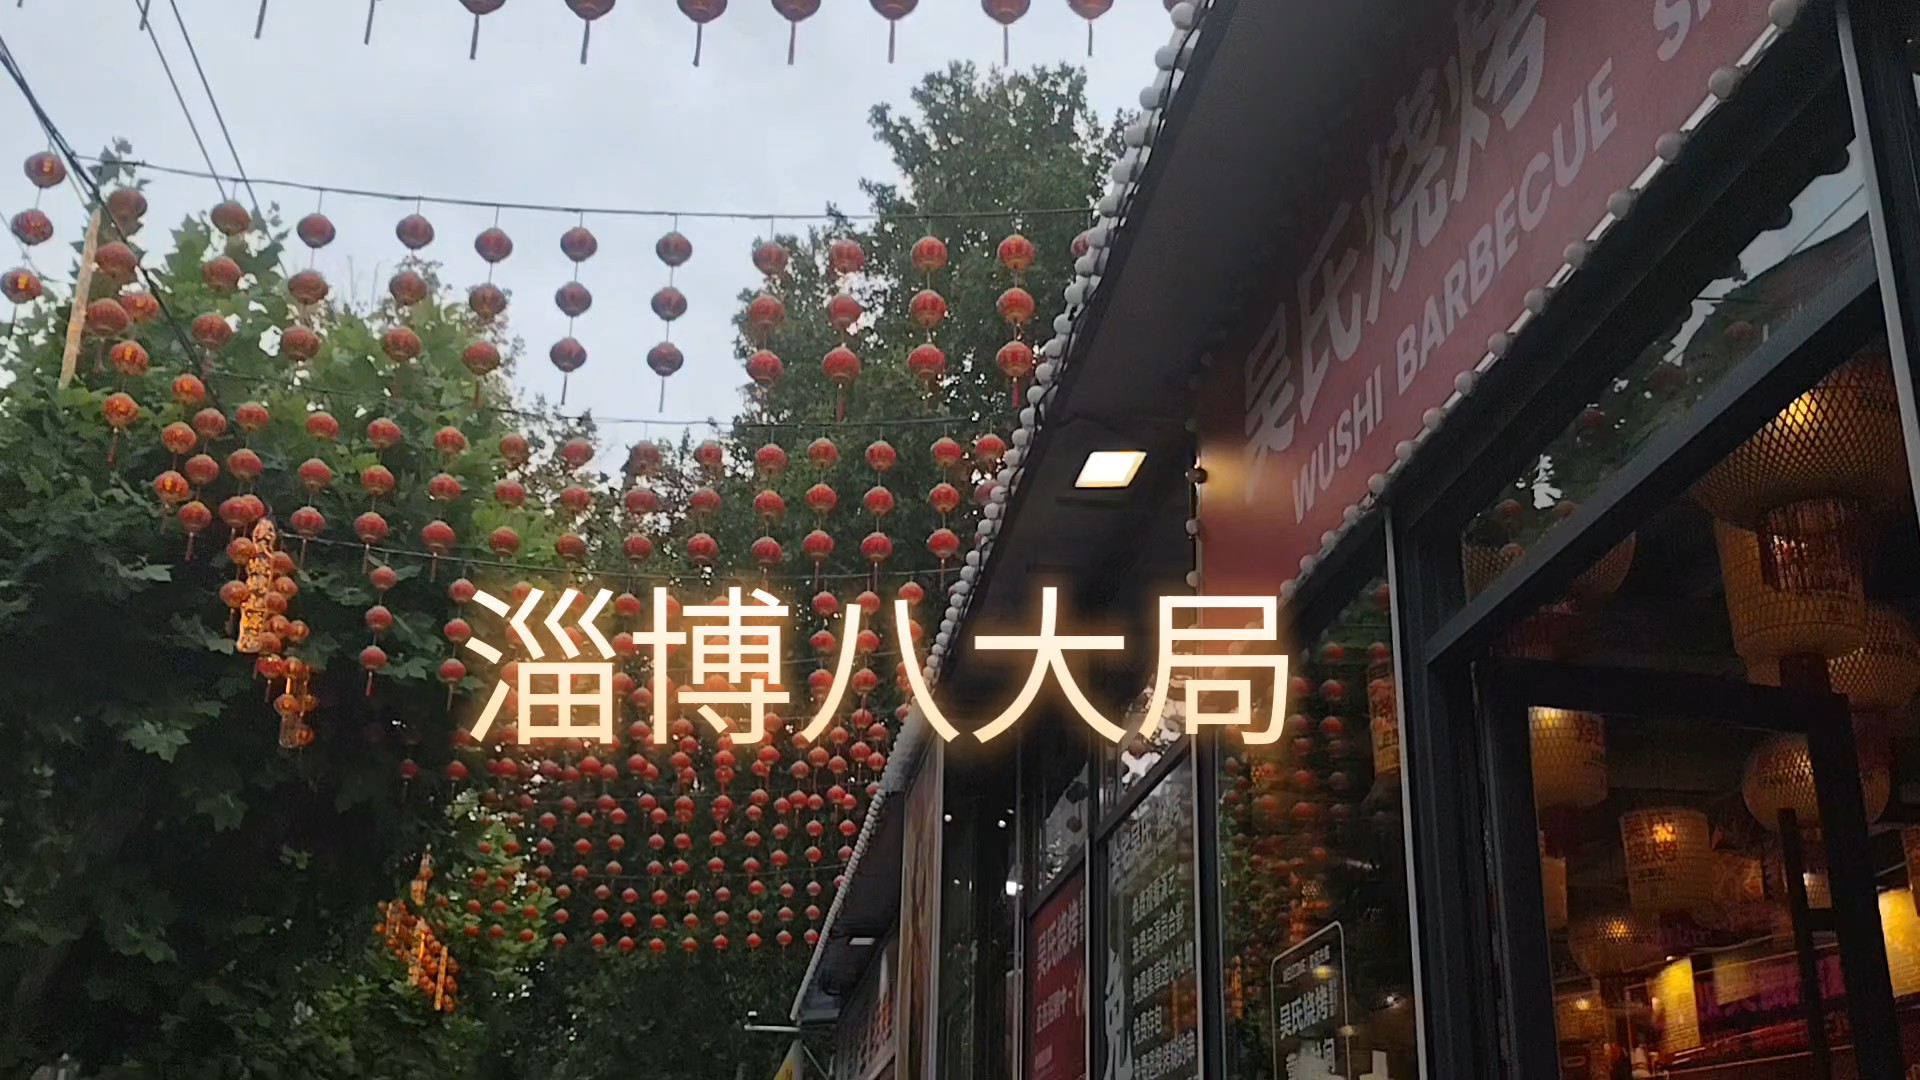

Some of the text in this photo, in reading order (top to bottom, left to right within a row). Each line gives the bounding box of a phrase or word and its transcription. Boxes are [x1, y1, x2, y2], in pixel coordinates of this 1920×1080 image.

[1243, 0, 1547, 503] 吴氏烧烤
[1291, 0, 1711, 525] WUSHI BARBECUE S
[1279, 984, 1329, 1041] 吴氏烧烤
